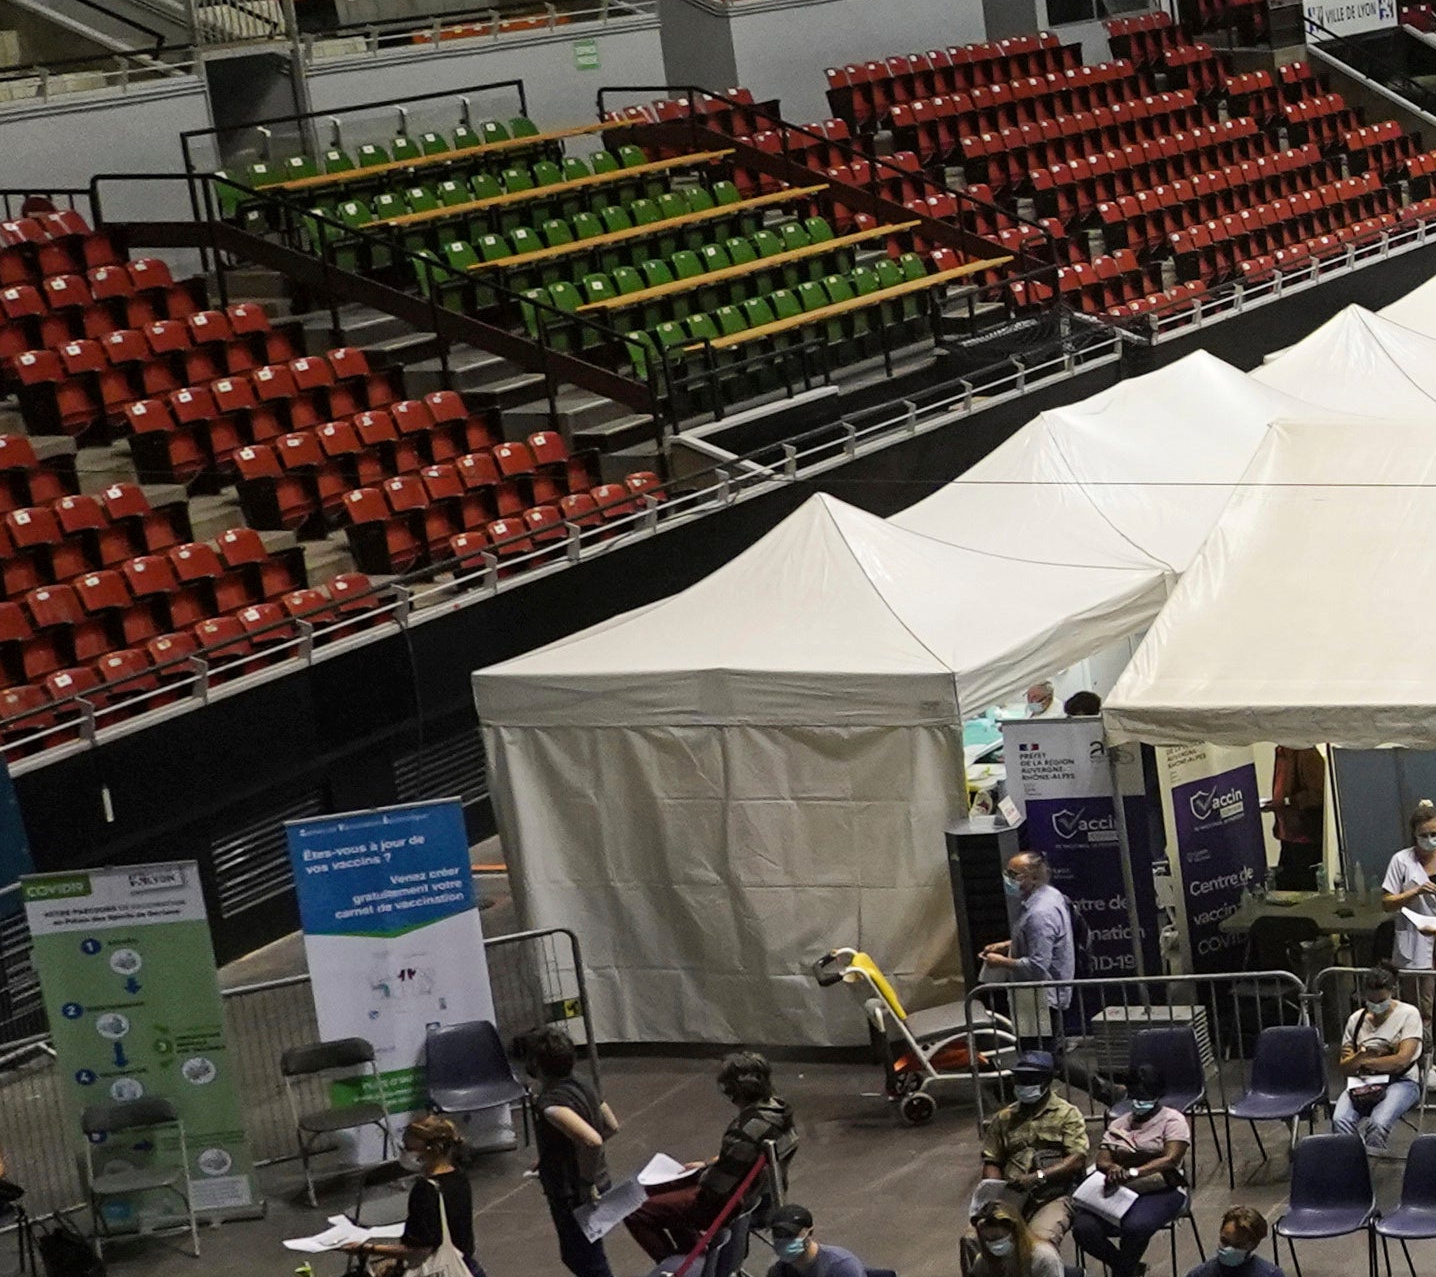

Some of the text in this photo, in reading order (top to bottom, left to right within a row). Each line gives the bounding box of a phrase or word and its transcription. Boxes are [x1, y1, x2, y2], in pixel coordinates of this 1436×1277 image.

[1325, 2, 1376, 24] VILLE DE LYON
[1053, 808, 1114, 835] Vacci
[381, 838, 406, 854] jour
[408, 835, 426, 845] de
[306, 864, 329, 875] vos
[332, 856, 381, 871] vaccins
[390, 872, 426, 885] Venez
[432, 879, 463, 892] votre
[1190, 865, 1254, 896] Centre de
[335, 891, 464, 920] carnet de vaccination
[1074, 898, 1105, 911] ntre
[1194, 902, 1237, 925] vaccin
